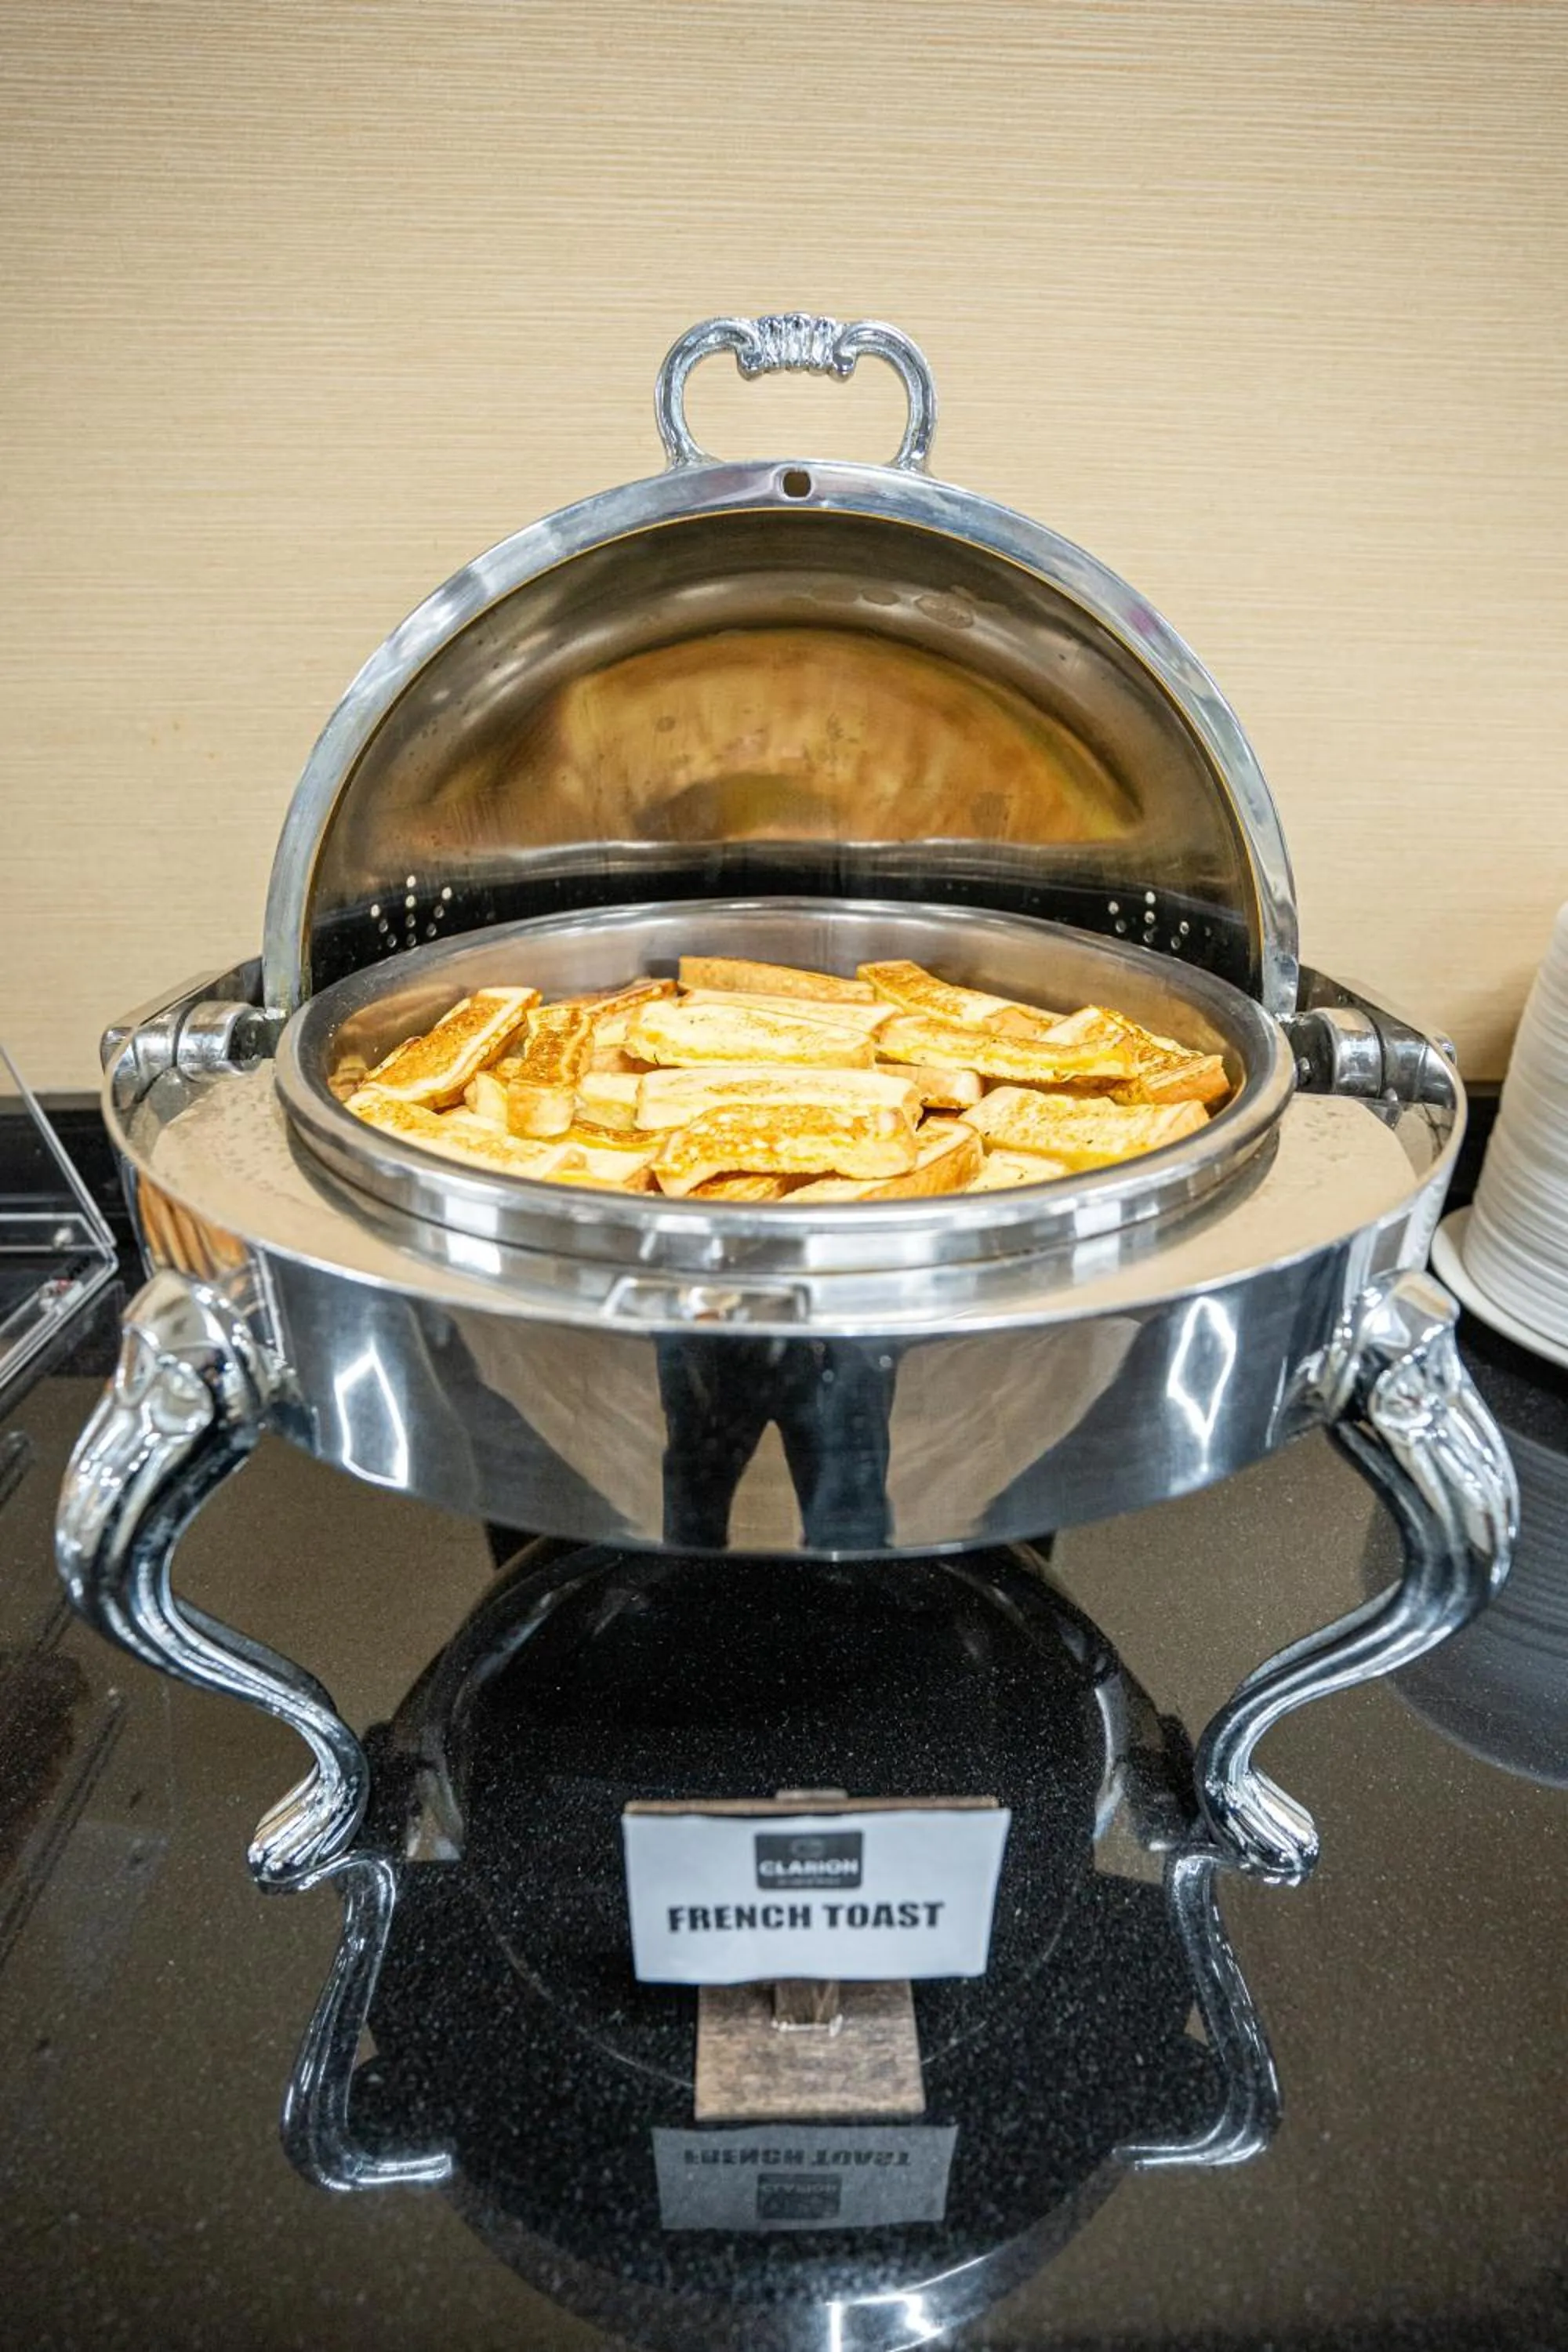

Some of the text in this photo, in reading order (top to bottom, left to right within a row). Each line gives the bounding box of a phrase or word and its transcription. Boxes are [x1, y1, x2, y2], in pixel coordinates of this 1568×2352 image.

[760, 1859, 858, 1877] CLARION
[667, 1900, 945, 1933] FRENCH TOAST
